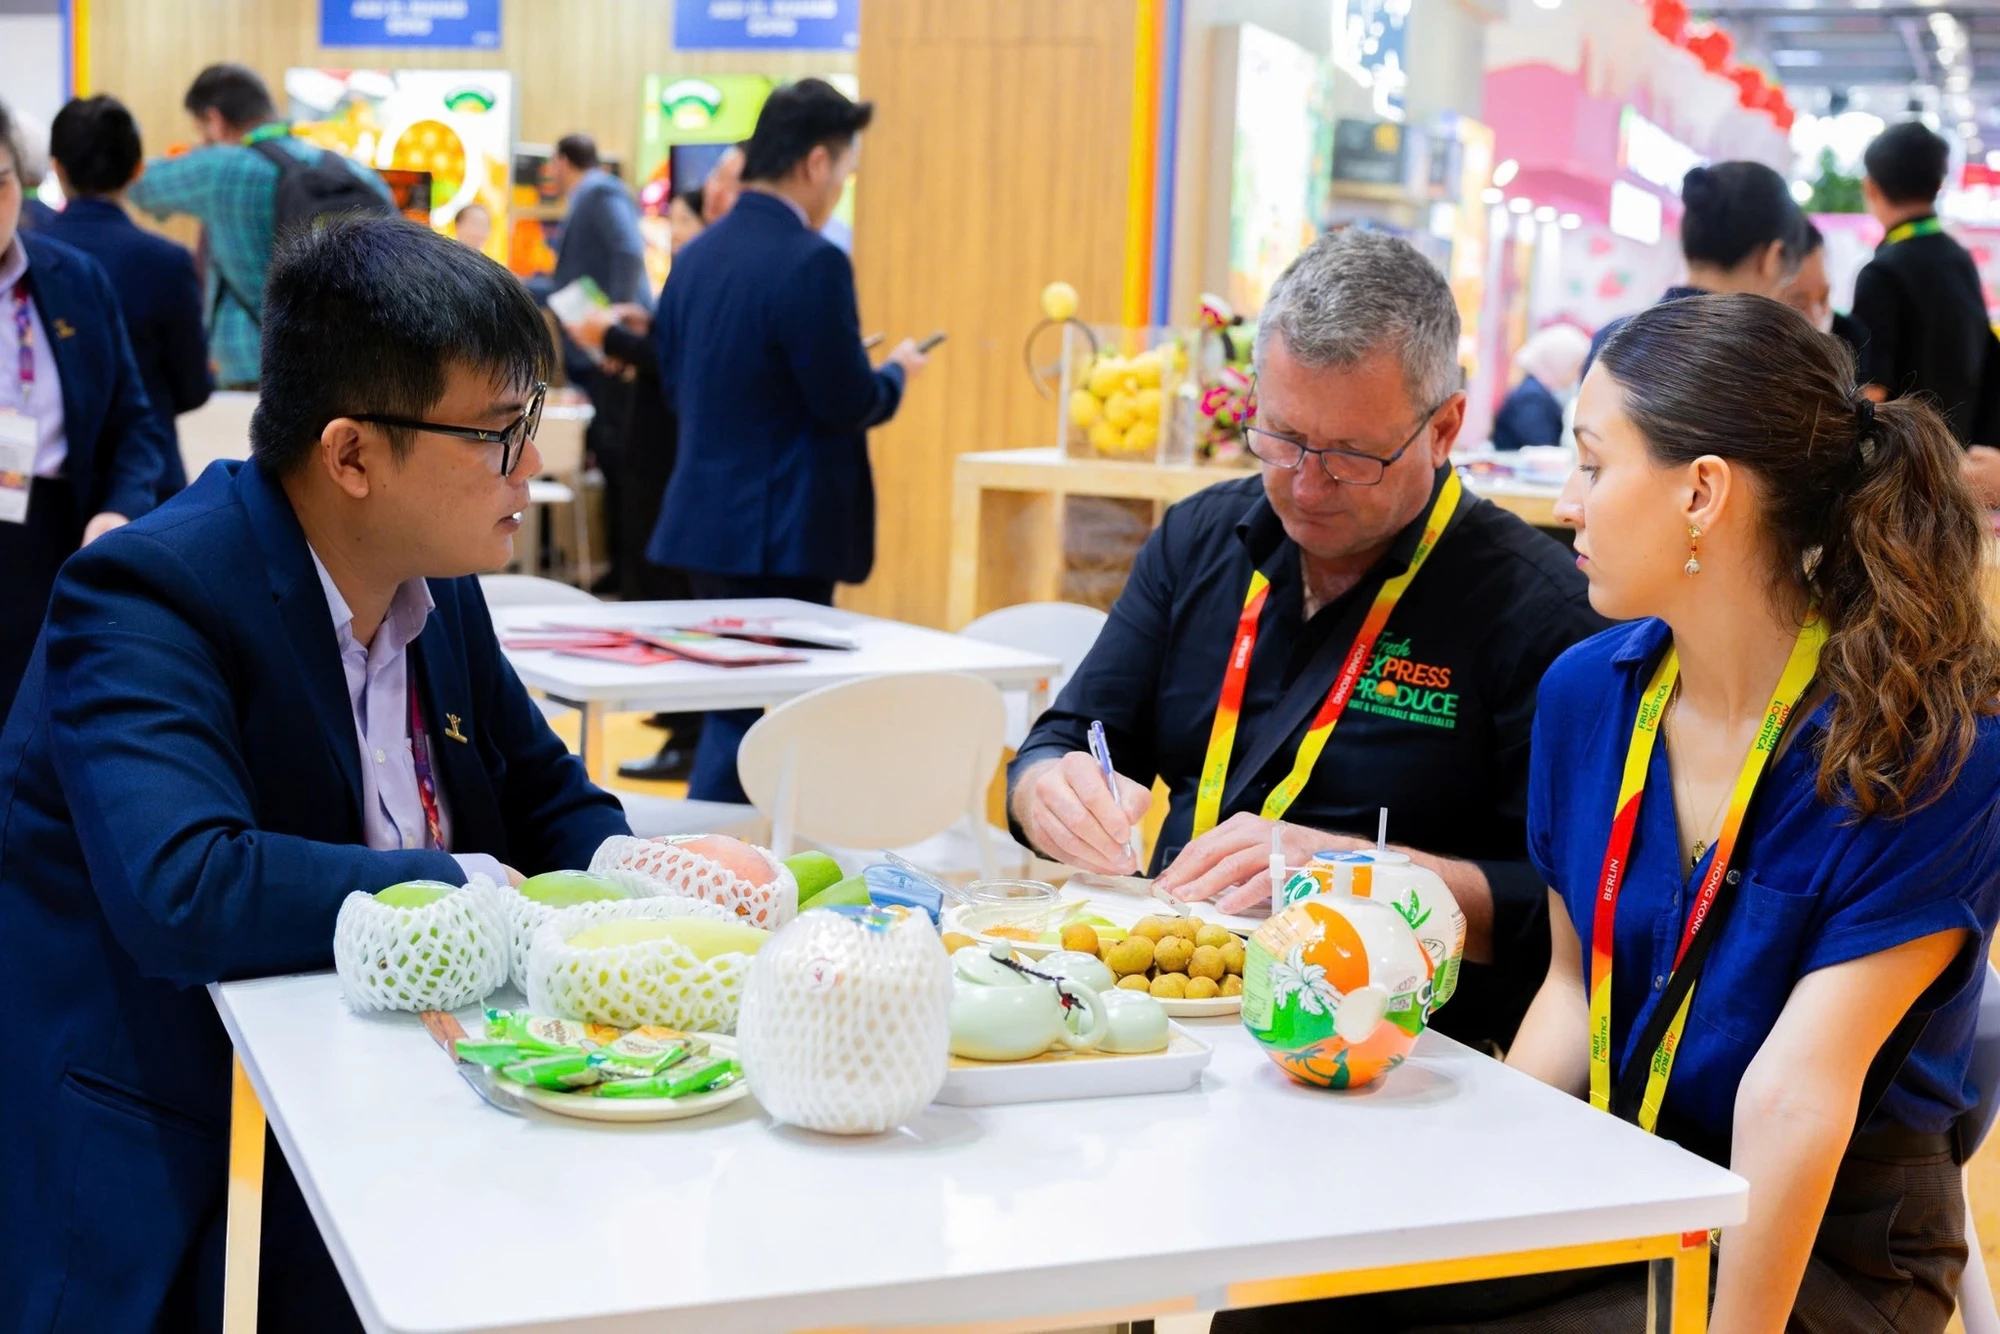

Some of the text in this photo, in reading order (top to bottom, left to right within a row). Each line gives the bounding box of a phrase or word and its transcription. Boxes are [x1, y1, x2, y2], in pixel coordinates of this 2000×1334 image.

[1331, 643, 1367, 705] HONG KONG
[1638, 701, 1650, 729] FRUIT
[1646, 684, 1669, 731] LOGISTICA
[1756, 700, 1783, 750] LOGISTICA
[1777, 704, 1790, 726] ASIA
[1603, 858, 1619, 901] BERLIN
[1691, 861, 1724, 935] HONG KONG
[1660, 1031, 1676, 1078] ASIA FRUIT
